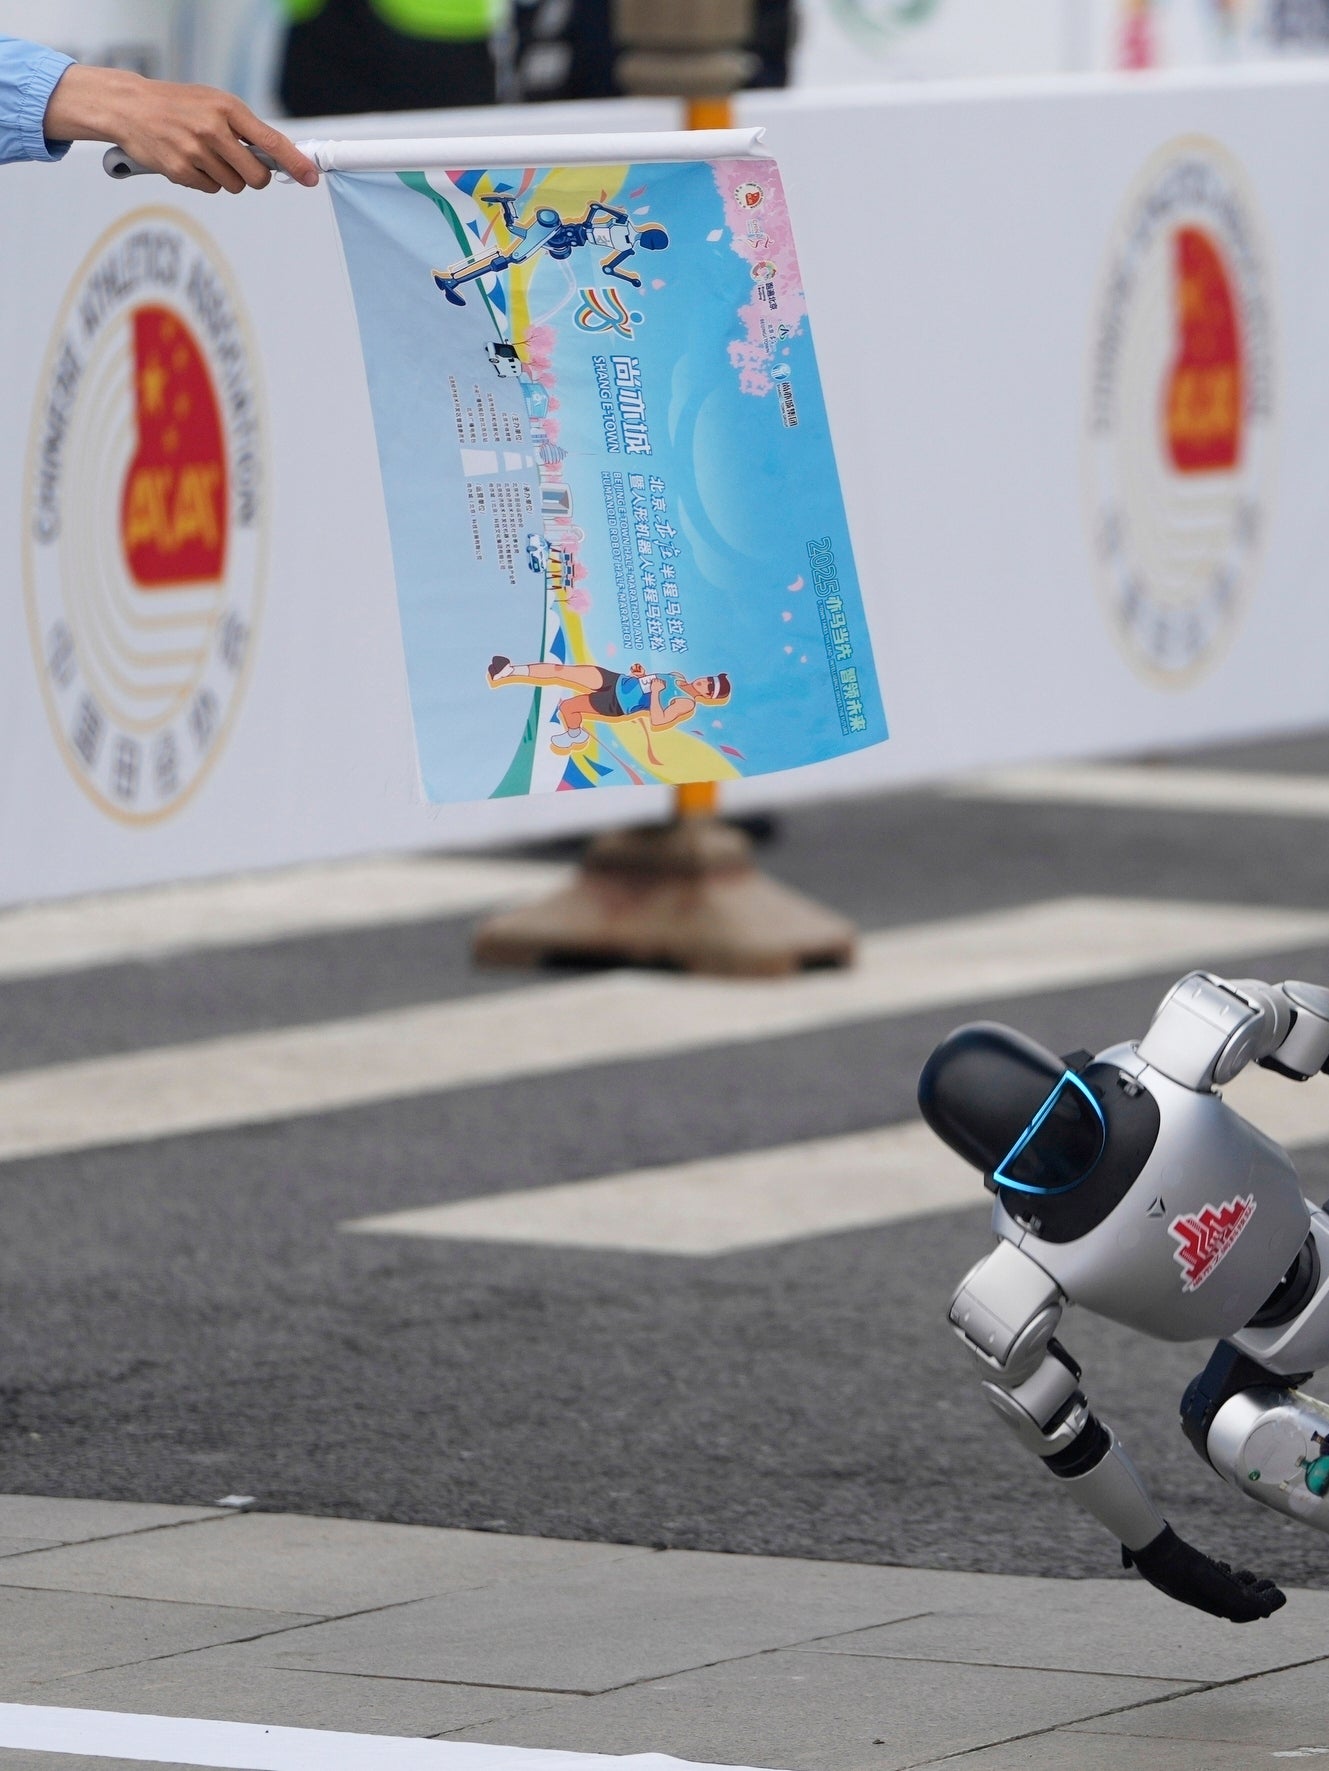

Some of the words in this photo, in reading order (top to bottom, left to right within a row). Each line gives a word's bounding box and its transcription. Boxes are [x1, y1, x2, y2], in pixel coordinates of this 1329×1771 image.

[592, 355, 611, 398] SHANG
[600, 402, 619, 452] E-TOWN
[610, 355, 653, 454] 尚亦城
[600, 471, 616, 526] HUMANOID
[612, 472, 625, 504] BEIJING
[608, 528, 622, 562] ROBOT
[617, 506, 630, 544] E-TOWN
[622, 547, 641, 626] HALF-MARATHON
[627, 473, 666, 651] 暨人形机器人半程马拉松
[806, 536, 839, 598] 2025
[613, 563, 633, 649] HALF-MARATHON
[632, 628, 644, 649] AND
[826, 595, 853, 661] 亦马当先
[840, 667, 867, 733] 智领未来
